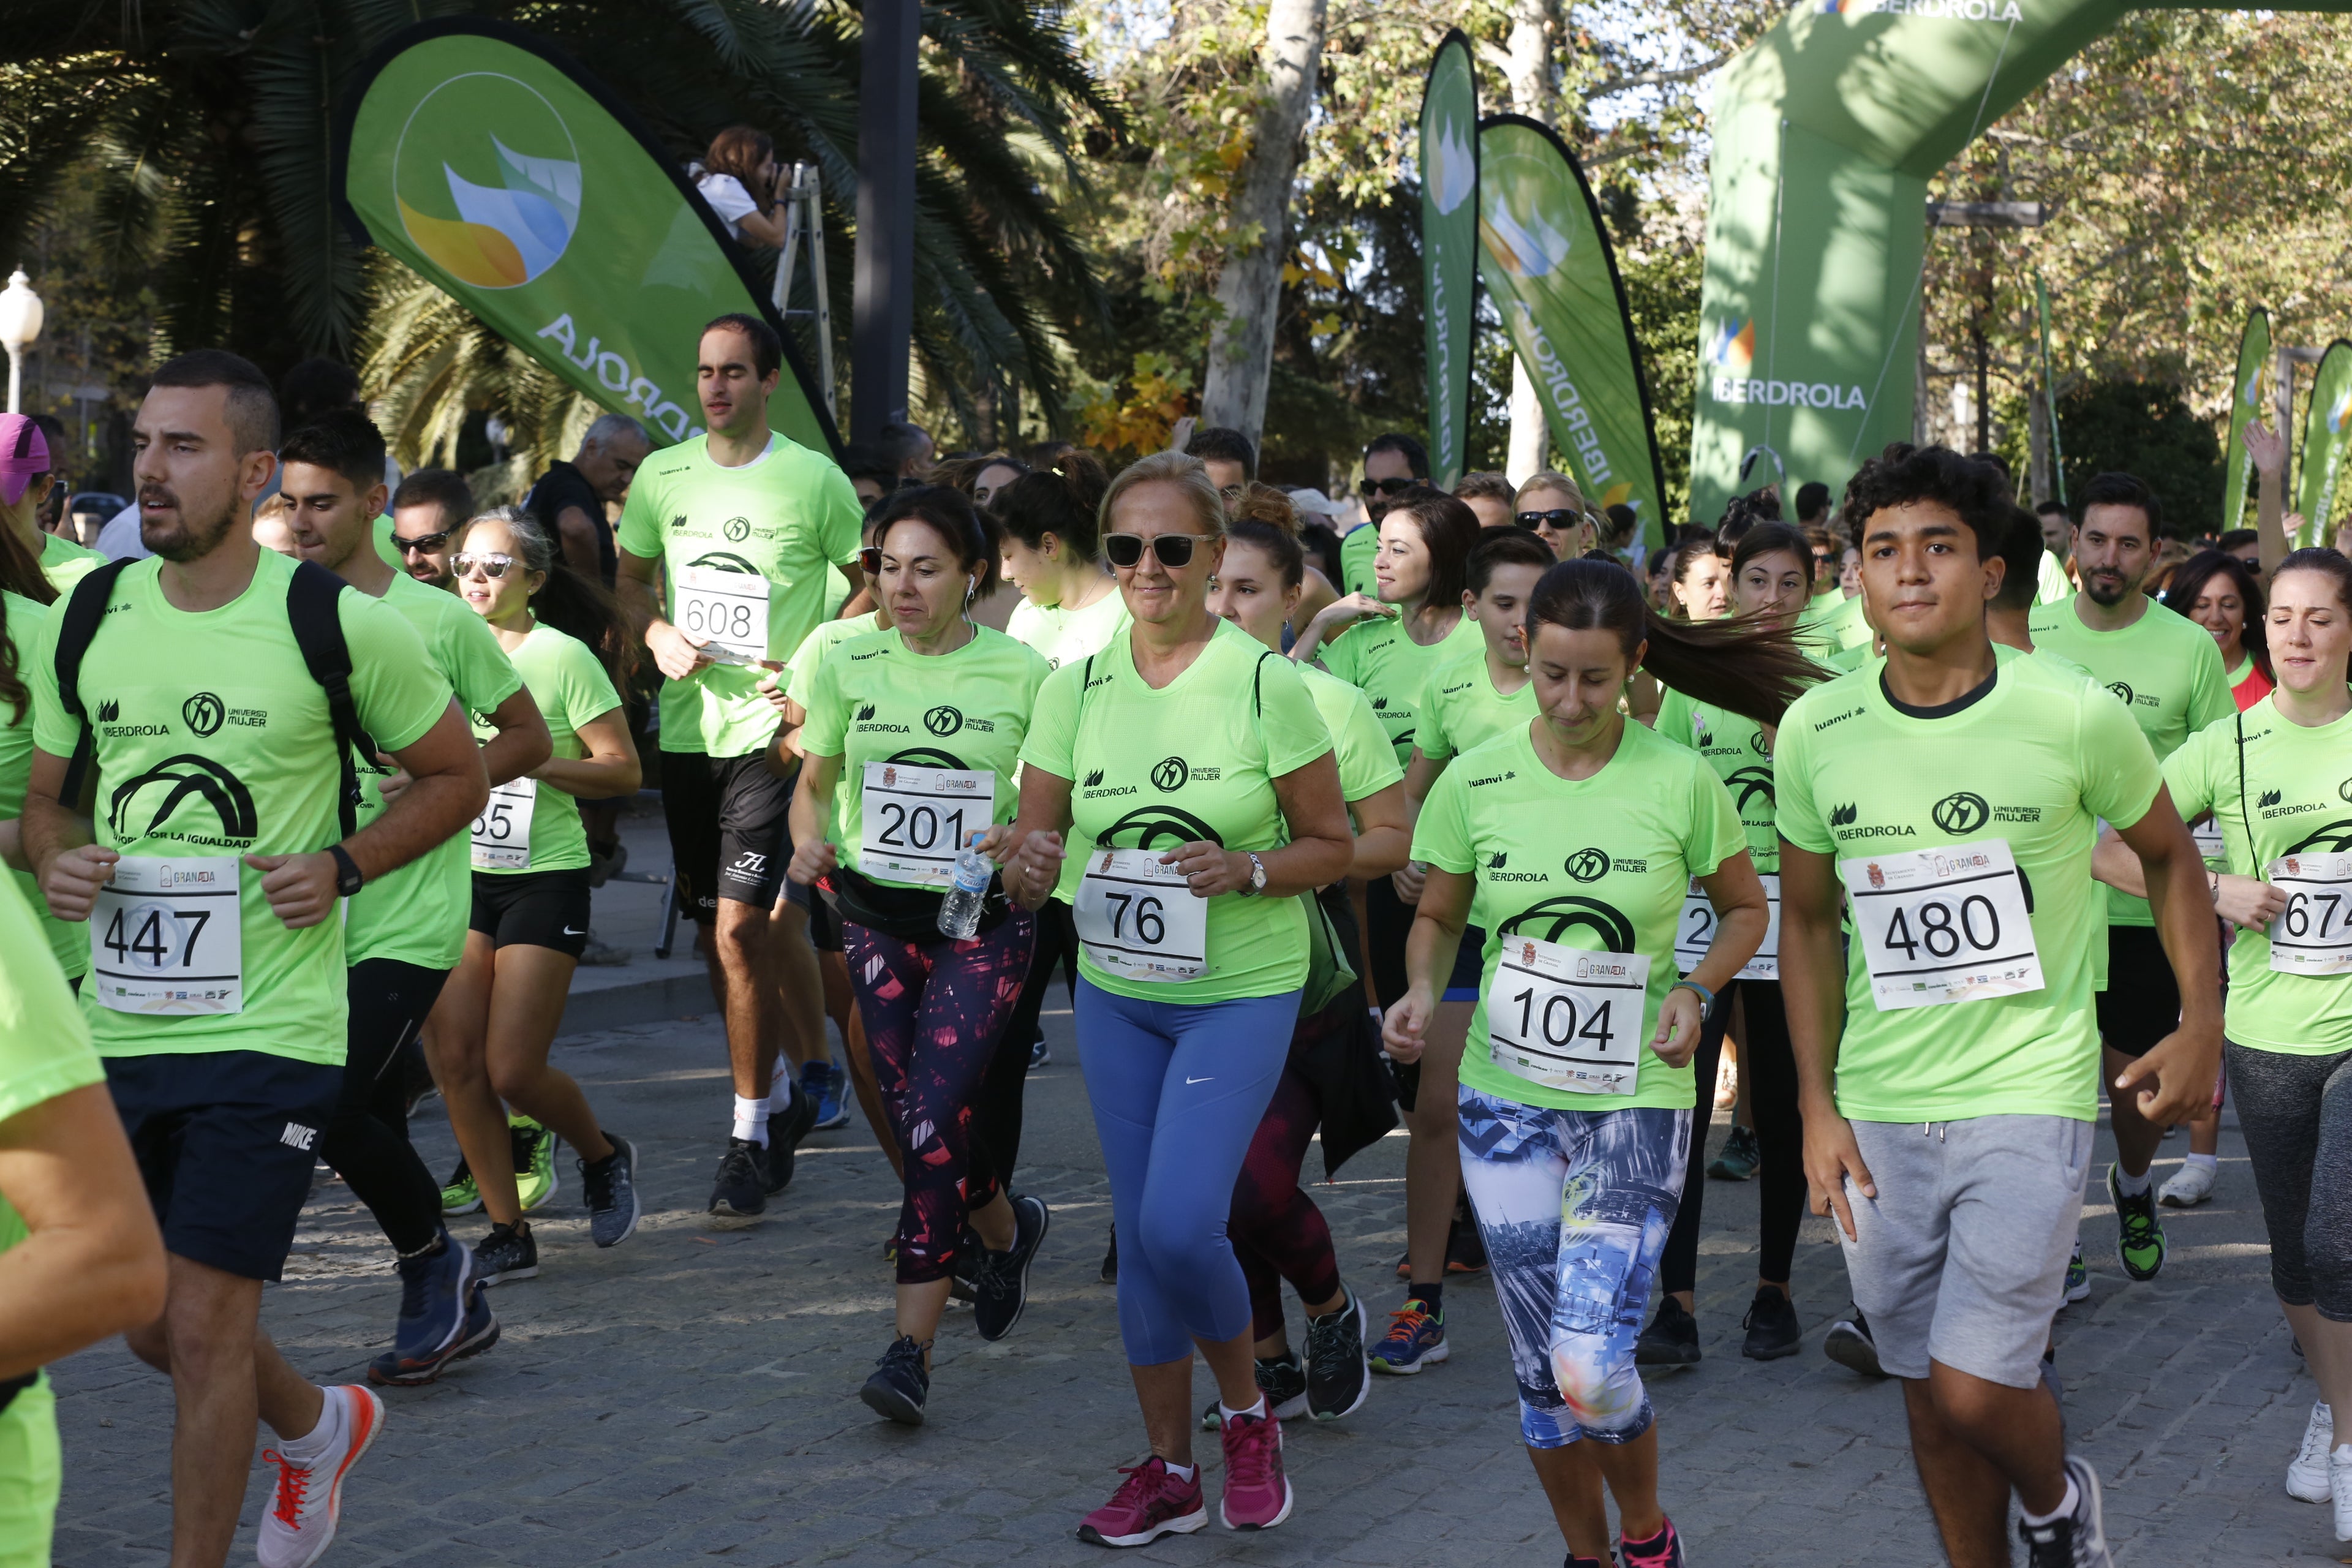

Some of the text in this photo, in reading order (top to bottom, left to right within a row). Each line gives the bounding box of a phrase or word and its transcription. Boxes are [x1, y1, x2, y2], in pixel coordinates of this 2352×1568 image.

[1713, 377, 1866, 410] IBERDROLA
[660, 467, 682, 477] luanvi
[673, 530, 714, 539] IBERDROLA
[687, 599, 751, 638] 608
[851, 649, 879, 661] luanvi
[2135, 698, 2160, 707] MUJER
[228, 708, 268, 718] UNIVERSO
[227, 716, 266, 728] MUJER
[965, 717, 995, 727] UNIVERSO
[1814, 709, 1852, 732] luanvi
[102, 725, 170, 737] IBERDROLA
[856, 723, 910, 734] IBERDROLA
[965, 723, 994, 733] MUJER
[1701, 747, 1742, 756] IBERDROLA
[1190, 772, 1221, 781] MUJER
[1468, 774, 1503, 788] luanvi
[946, 780, 976, 789] GRANADA
[1083, 785, 1137, 799] IBERDROLA
[2262, 802, 2328, 820] IBERDROLA
[1993, 813, 2041, 823] MUJER
[879, 802, 963, 851] 201
[1837, 825, 1917, 841] IBERDROLA
[170, 832, 184, 841] LA
[187, 834, 251, 848] IGUALDAD
[1613, 864, 1647, 873] MUJER
[1950, 855, 1990, 870] GRANADA
[174, 871, 215, 883] GRANADA
[1489, 872, 1548, 882] IBERDROLA
[1105, 892, 1165, 944] 76
[1885, 894, 2000, 960] 480
[104, 907, 211, 967] 447
[1589, 964, 1626, 976] GRANADA
[1513, 987, 1615, 1052] 104
[279, 1121, 318, 1151] NIKE
